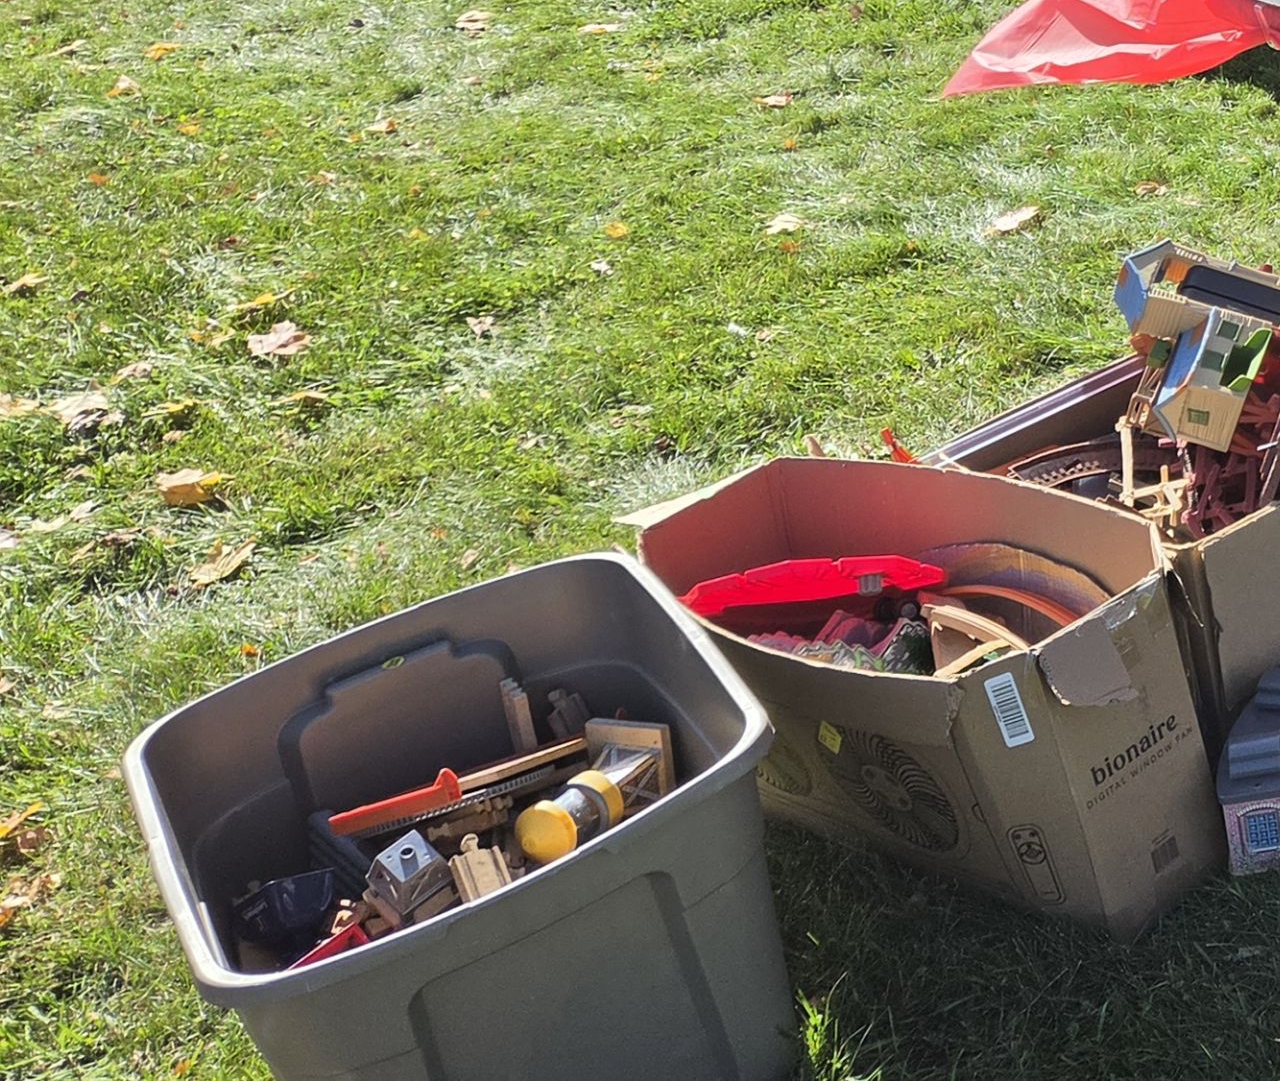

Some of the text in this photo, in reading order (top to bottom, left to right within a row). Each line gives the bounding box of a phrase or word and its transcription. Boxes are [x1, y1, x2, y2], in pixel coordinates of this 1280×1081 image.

[1086, 727, 1193, 810] DIGITAL WINDOW FAN
[1090, 714, 1178, 787] bionaire
